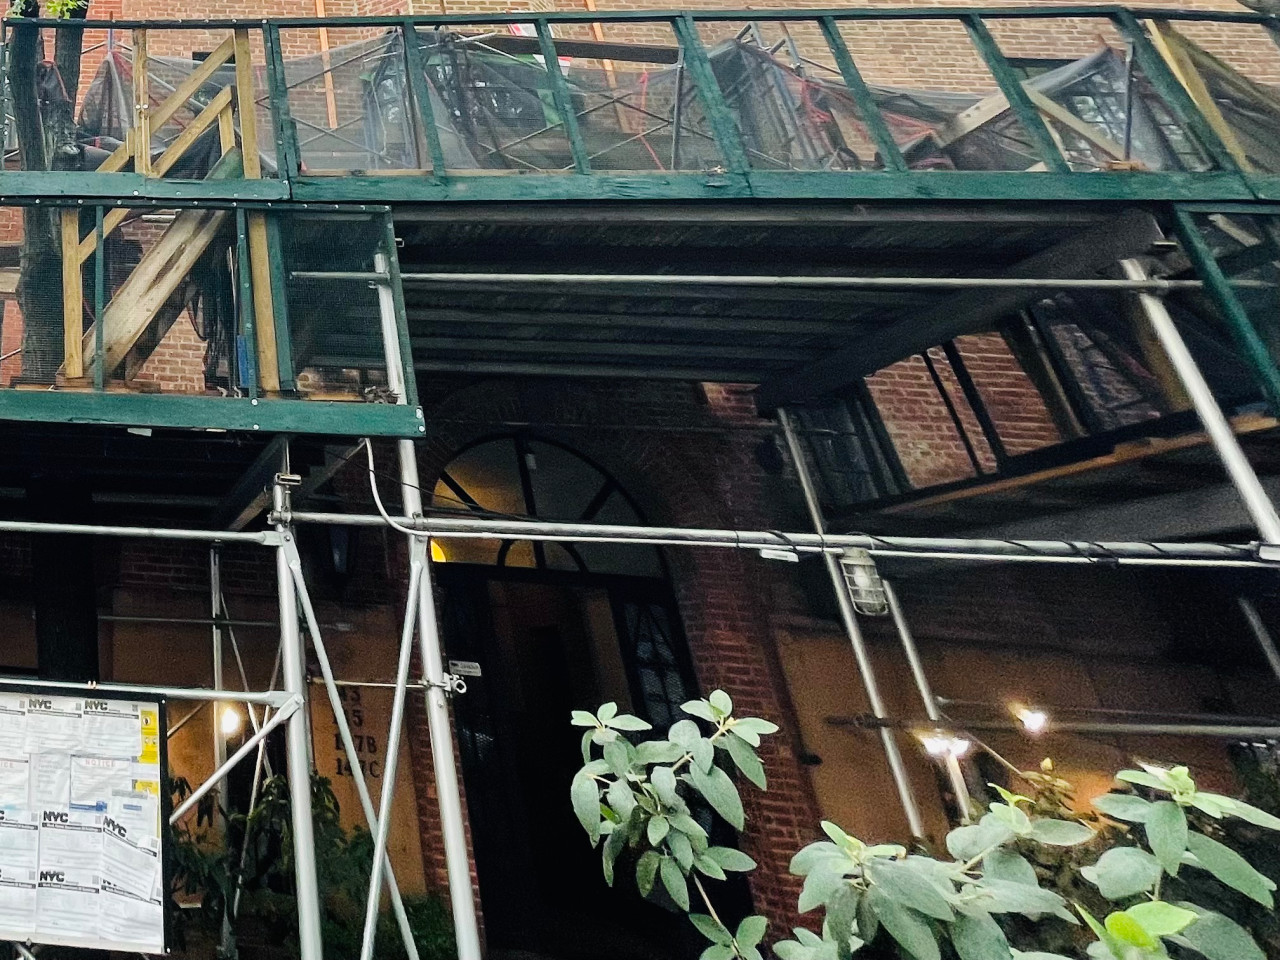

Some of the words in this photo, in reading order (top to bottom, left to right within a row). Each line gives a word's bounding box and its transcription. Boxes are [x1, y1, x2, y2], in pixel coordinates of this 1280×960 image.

[28, 699, 51, 709] NYC
[84, 700, 108, 711] NYC
[43, 810, 68, 823] NYC
[103, 816, 127, 838] NYC
[40, 870, 65, 882] NYC
